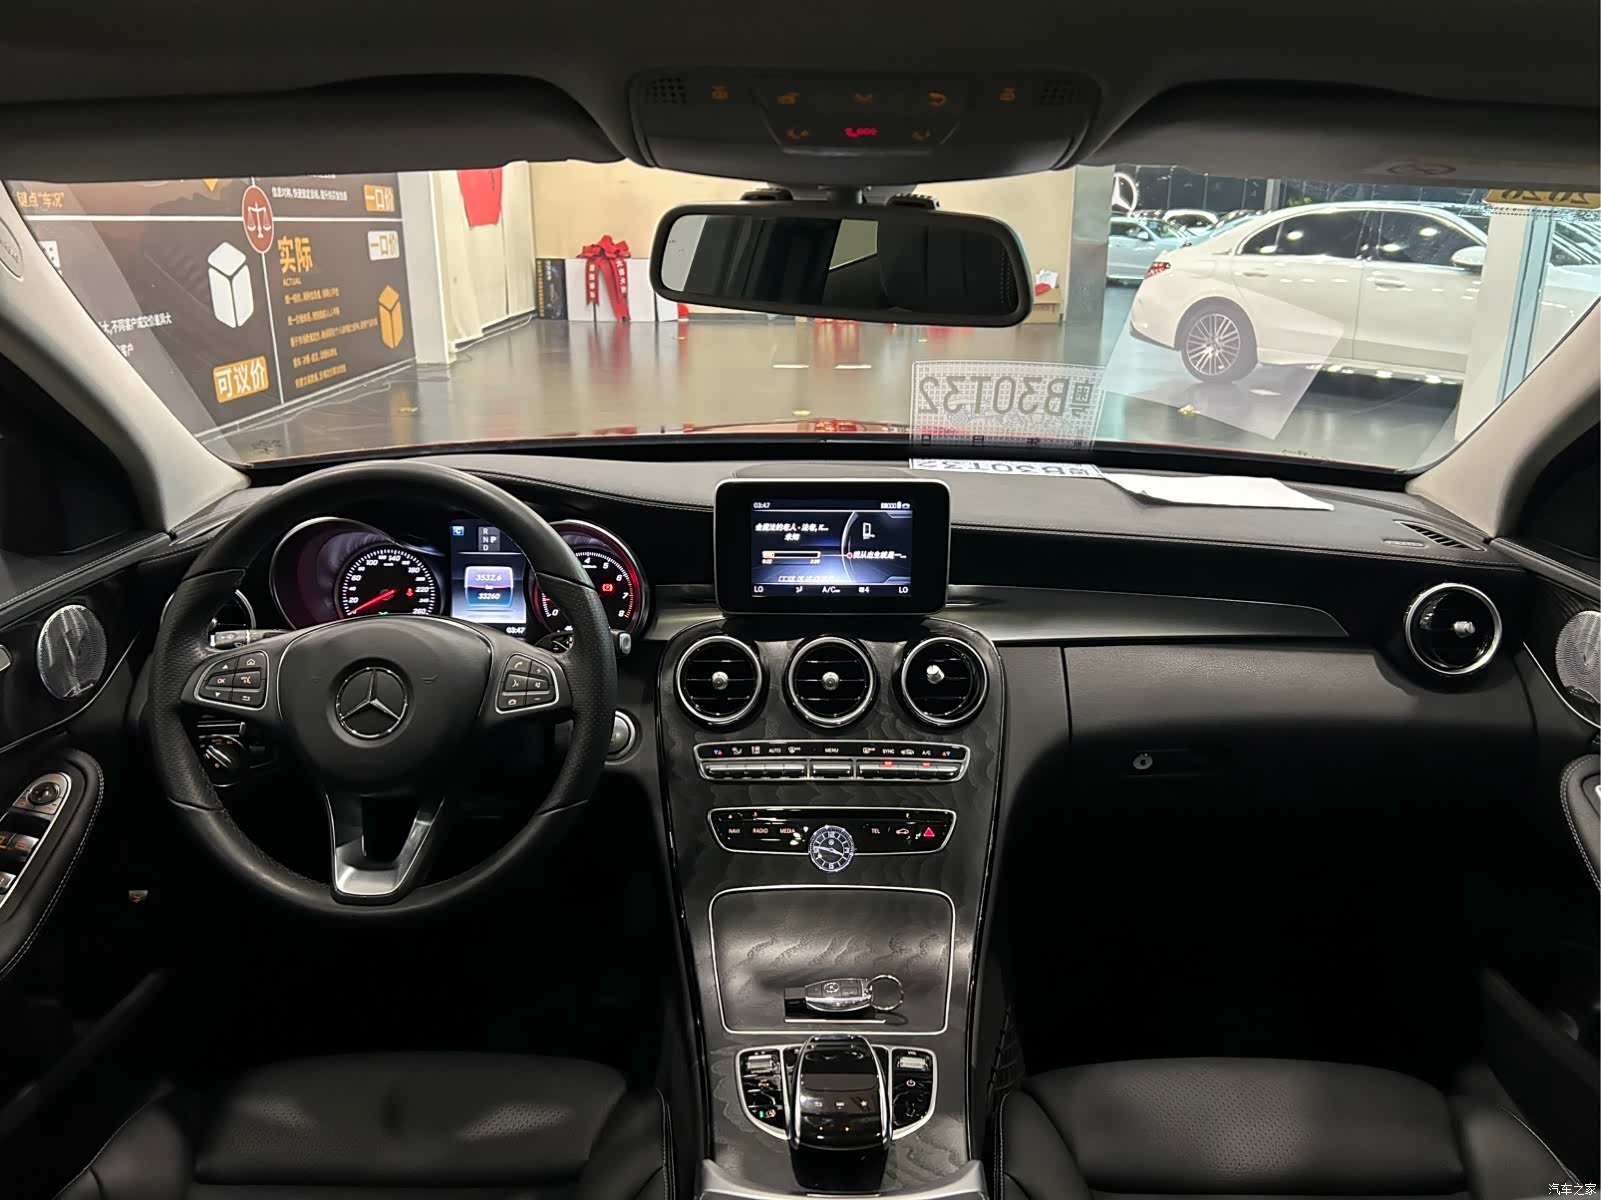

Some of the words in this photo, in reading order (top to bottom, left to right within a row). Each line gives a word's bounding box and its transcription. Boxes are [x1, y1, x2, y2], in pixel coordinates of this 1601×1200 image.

[278, 236, 313, 274] 实际
[215, 359, 265, 398] 可议价
